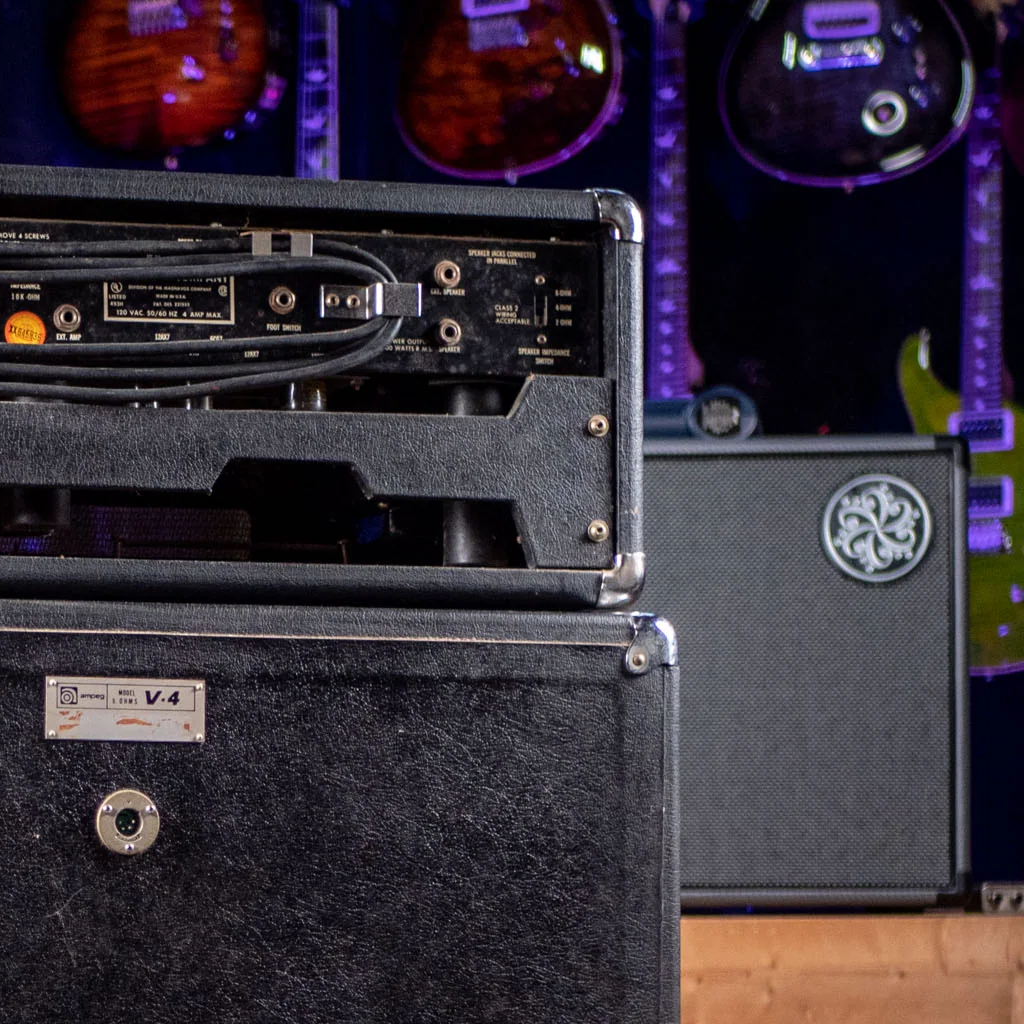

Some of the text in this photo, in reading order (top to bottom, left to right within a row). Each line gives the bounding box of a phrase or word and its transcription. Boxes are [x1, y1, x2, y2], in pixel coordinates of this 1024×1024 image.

[18, 232, 23, 240] 4
[24, 232, 50, 240] SCREWS
[443, 288, 465, 296] SPEAKER
[266, 323, 302, 332] FOOT SWITCH
[518, 347, 570, 357] SPEAKER IMPEDANCE
[535, 357, 554, 365] SWITCH
[118, 689, 135, 697] MODEL
